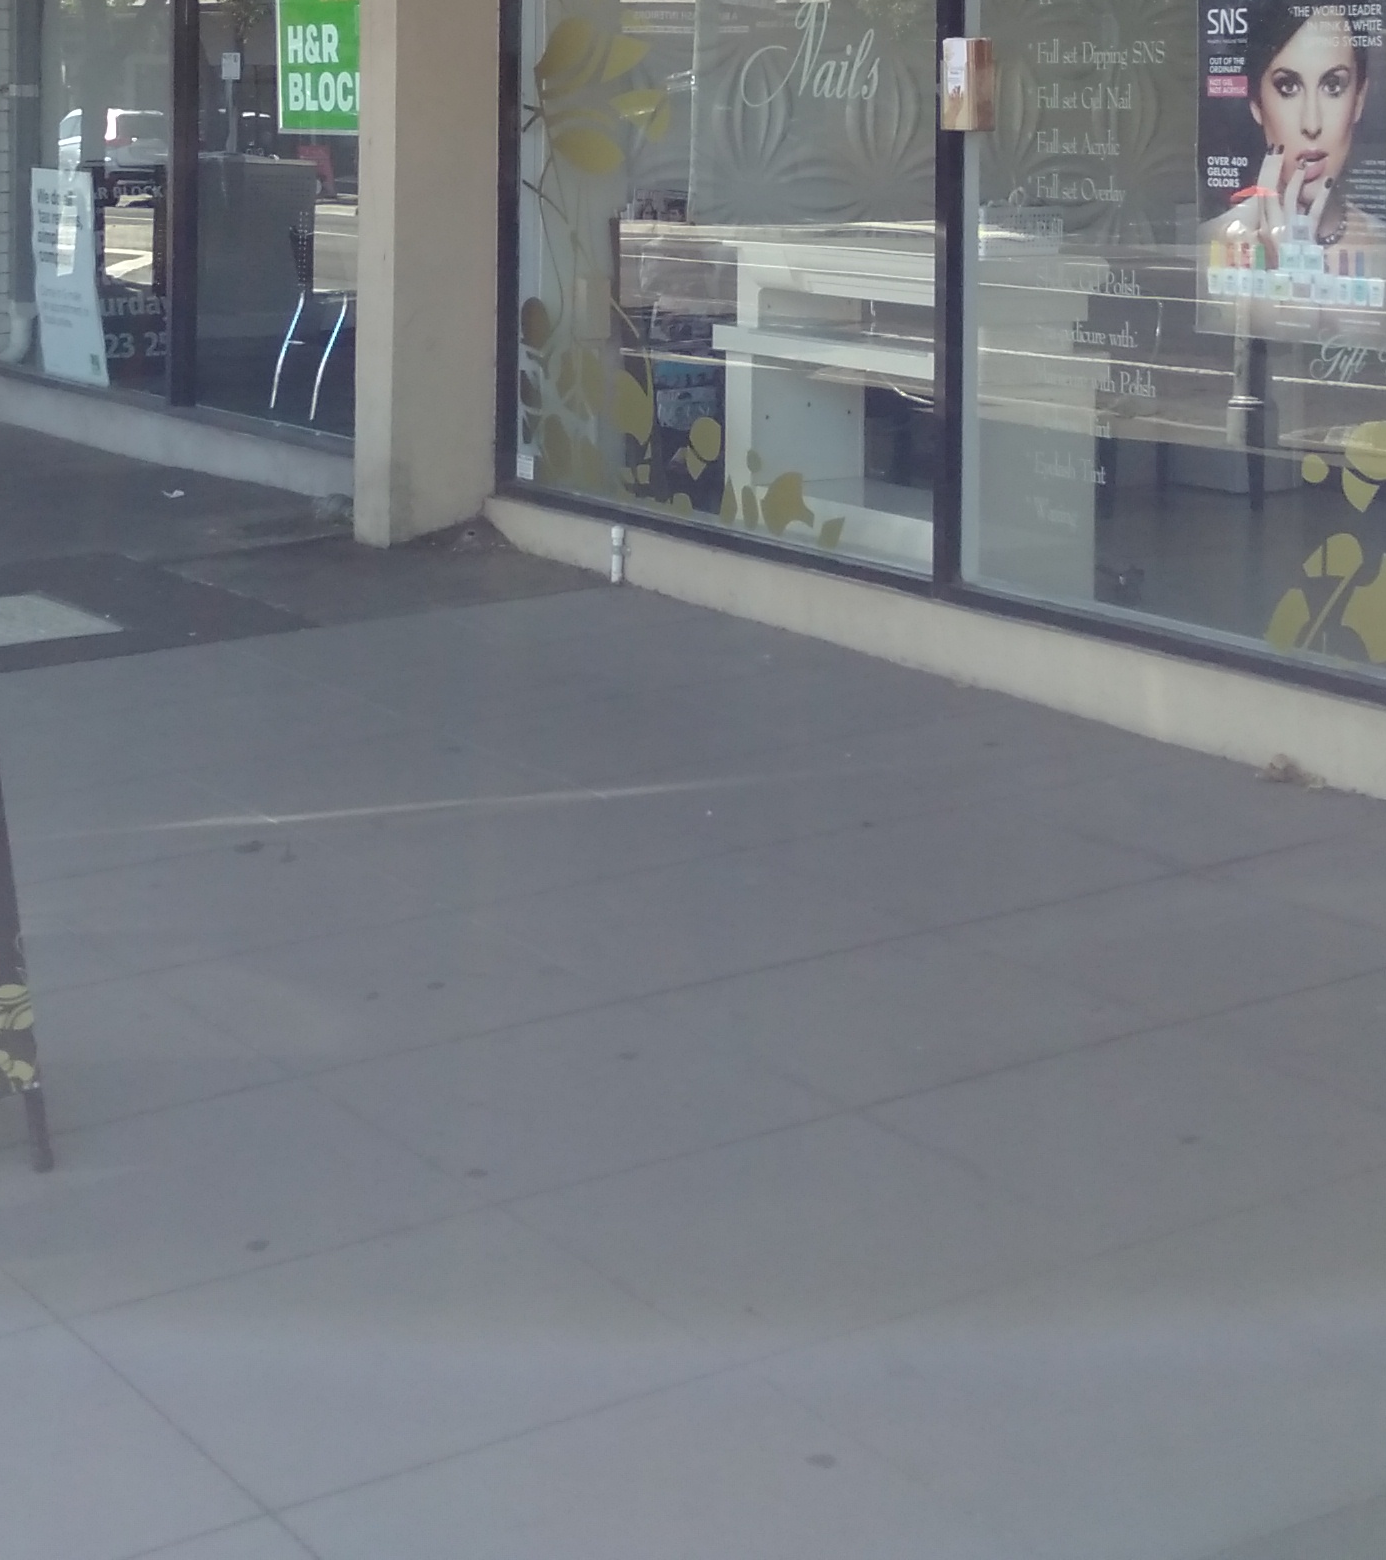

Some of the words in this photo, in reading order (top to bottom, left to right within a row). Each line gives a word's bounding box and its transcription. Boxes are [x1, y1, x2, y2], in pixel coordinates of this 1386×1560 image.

[1206, 7, 1248, 35] SNS
[1293, 6, 1310, 17] THE
[1312, 5, 1346, 17] WORLD
[1348, 3, 1382, 16] LEADER
[1353, 19, 1383, 31] WHITE
[287, 23, 340, 65] H&R
[1036, 38, 1060, 64] Full
[1062, 45, 1078, 64] set
[1081, 41, 1128, 70] Dipping
[1132, 40, 1166, 64] SNS
[1343, 35, 1383, 47] SYSTEMS
[1036, 83, 1060, 109] Full
[1062, 92, 1078, 109] set
[1081, 83, 1102, 109] Gel
[1106, 83, 1132, 110] Nail
[1036, 128, 1059, 154] Full
[1062, 137, 1077, 154] set
[1081, 129, 1121, 160] Acrylic
[1207, 156, 1230, 166] OVER
[1231, 156, 1248, 166] 400
[1207, 167, 1239, 177] GELOUS
[1036, 173, 1059, 199] Full
[1062, 182, 1078, 199] set
[1081, 175, 1126, 207] Overlay
[1207, 177, 1240, 188] COLORS
[1105, 268, 1141, 297] Polish
[1310, 330, 1369, 383] Gift
[1119, 368, 1157, 398] Polish
